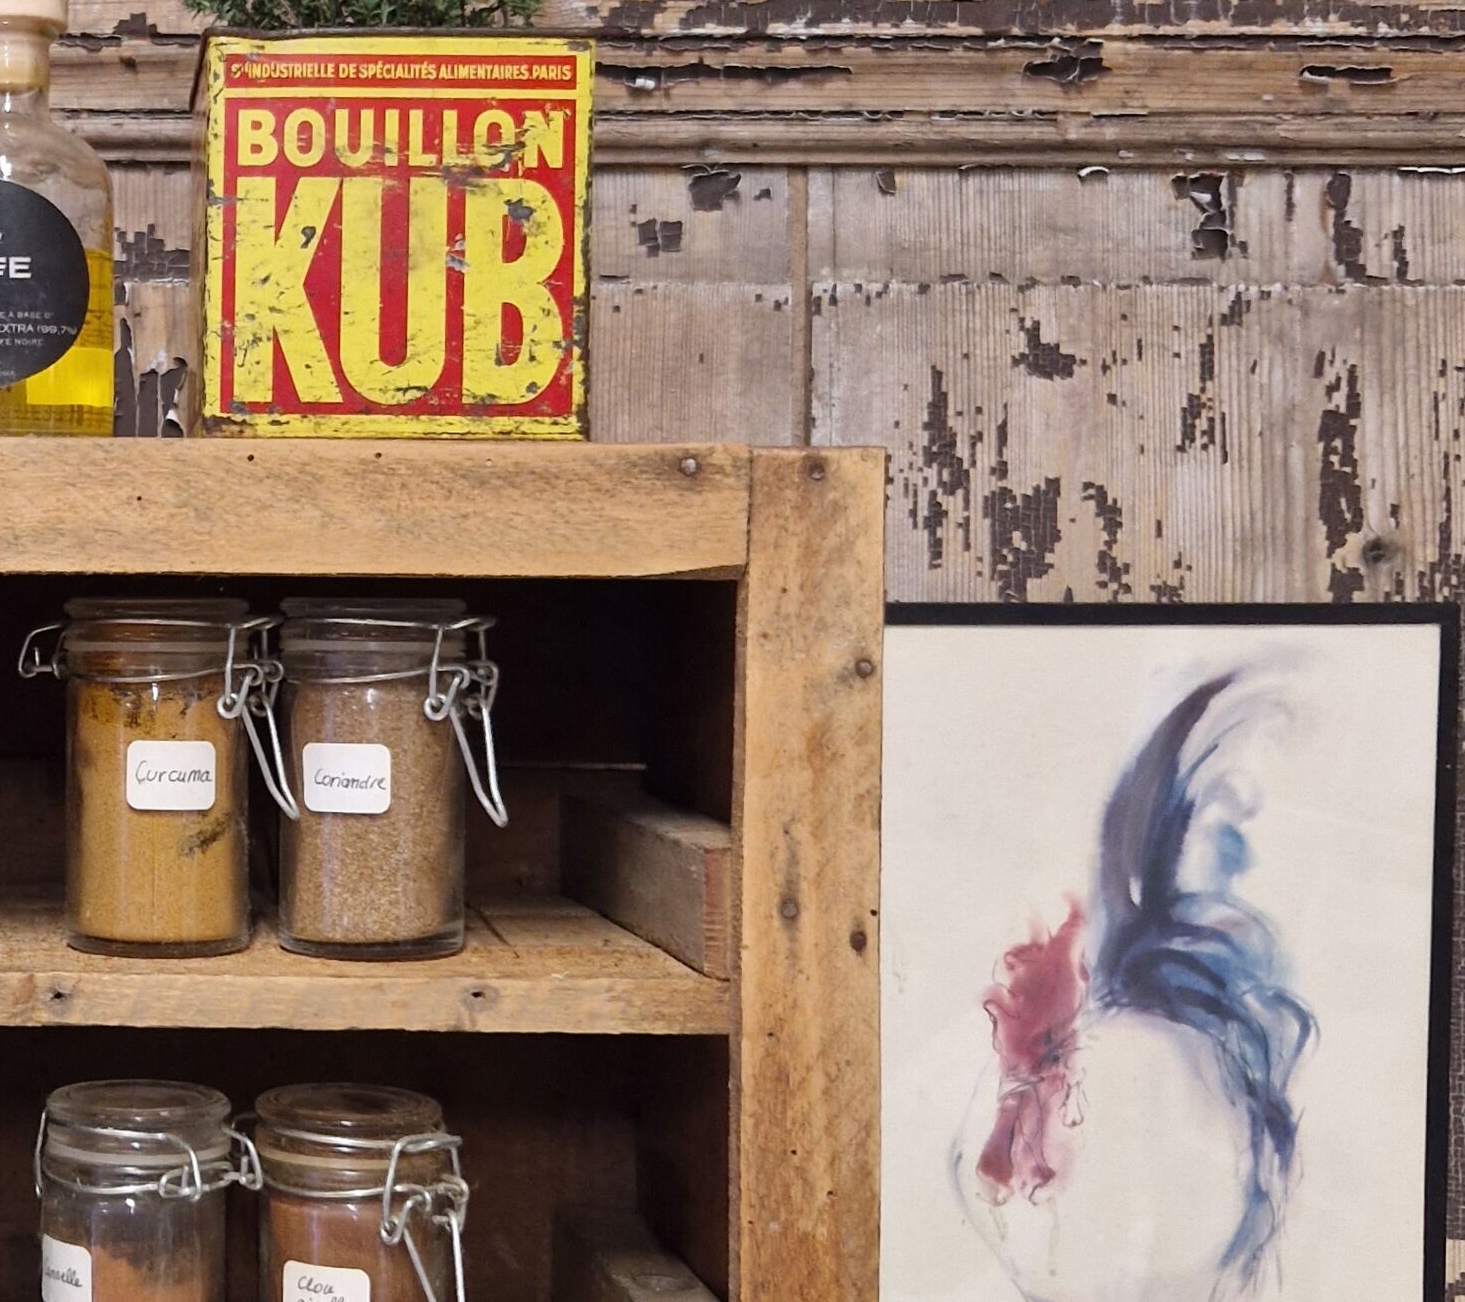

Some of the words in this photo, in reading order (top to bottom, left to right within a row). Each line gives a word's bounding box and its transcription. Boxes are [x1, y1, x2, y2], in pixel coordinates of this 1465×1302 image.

[248, 62, 335, 79] INDUSTRIELLE
[338, 63, 357, 79] DE
[358, 60, 437, 80] SPÉCIALITÉS
[236, 107, 567, 169] BOUILLON
[232, 176, 566, 406] KUB
[135, 759, 214, 785] Curcuma
[313, 767, 388, 792] Coriandre
[296, 1274, 336, 1296] Clou
